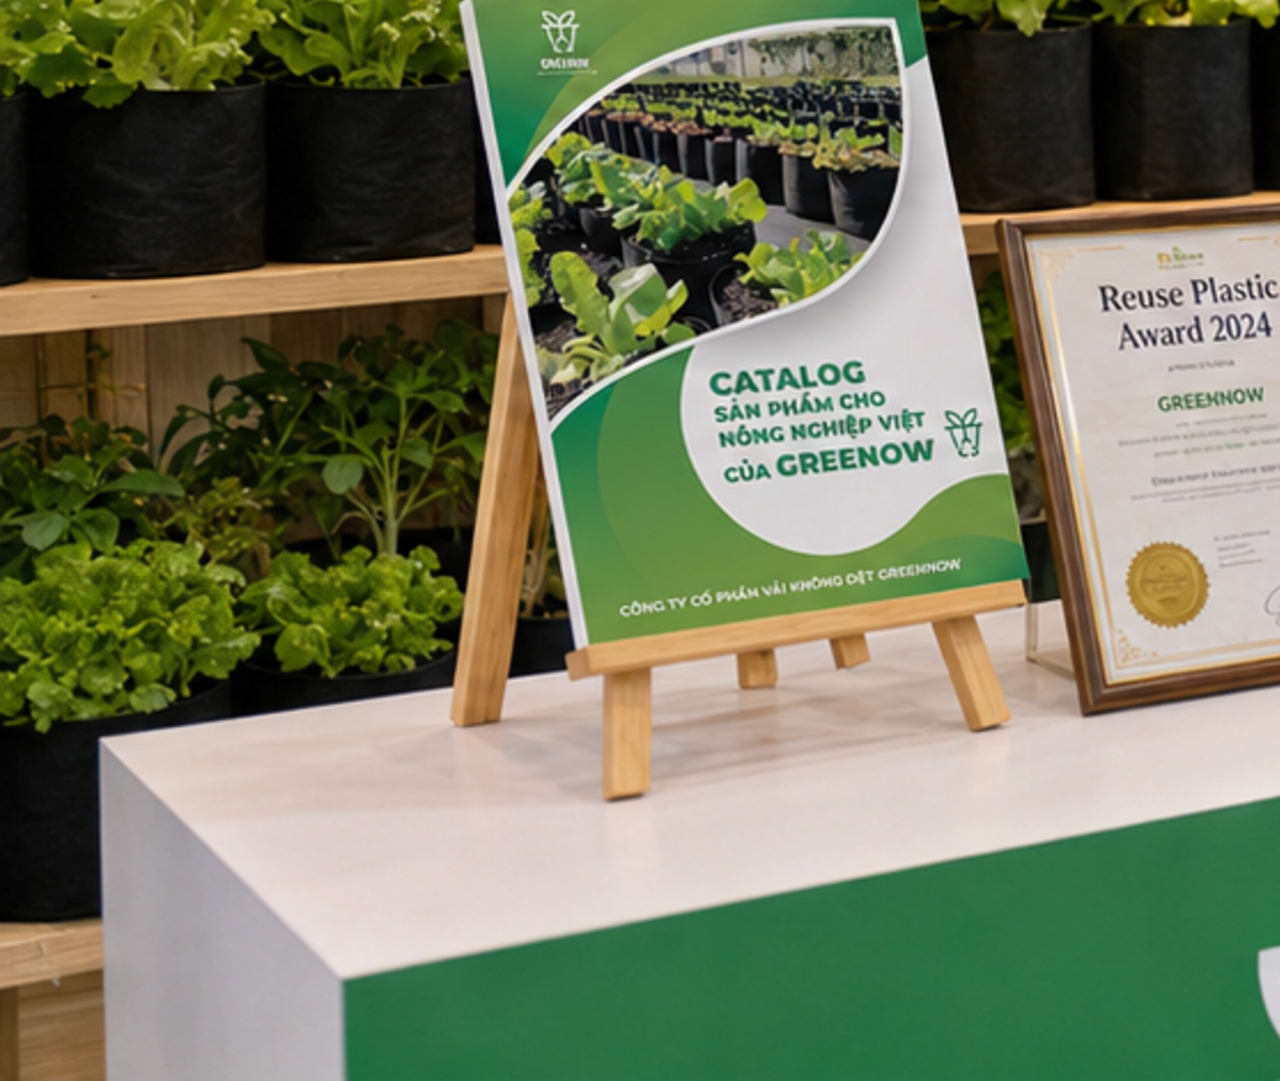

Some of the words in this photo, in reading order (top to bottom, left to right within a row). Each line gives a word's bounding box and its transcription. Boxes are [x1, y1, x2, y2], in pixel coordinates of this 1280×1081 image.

[1098, 283, 1184, 312] Reuse
[1190, 273, 1280, 306] Plastic
[1118, 315, 1204, 351] Award
[1209, 311, 1273, 342] 2024
[709, 360, 866, 396] CATALOG
[839, 390, 886, 410] CHO
[776, 438, 935, 477] GREENOW
